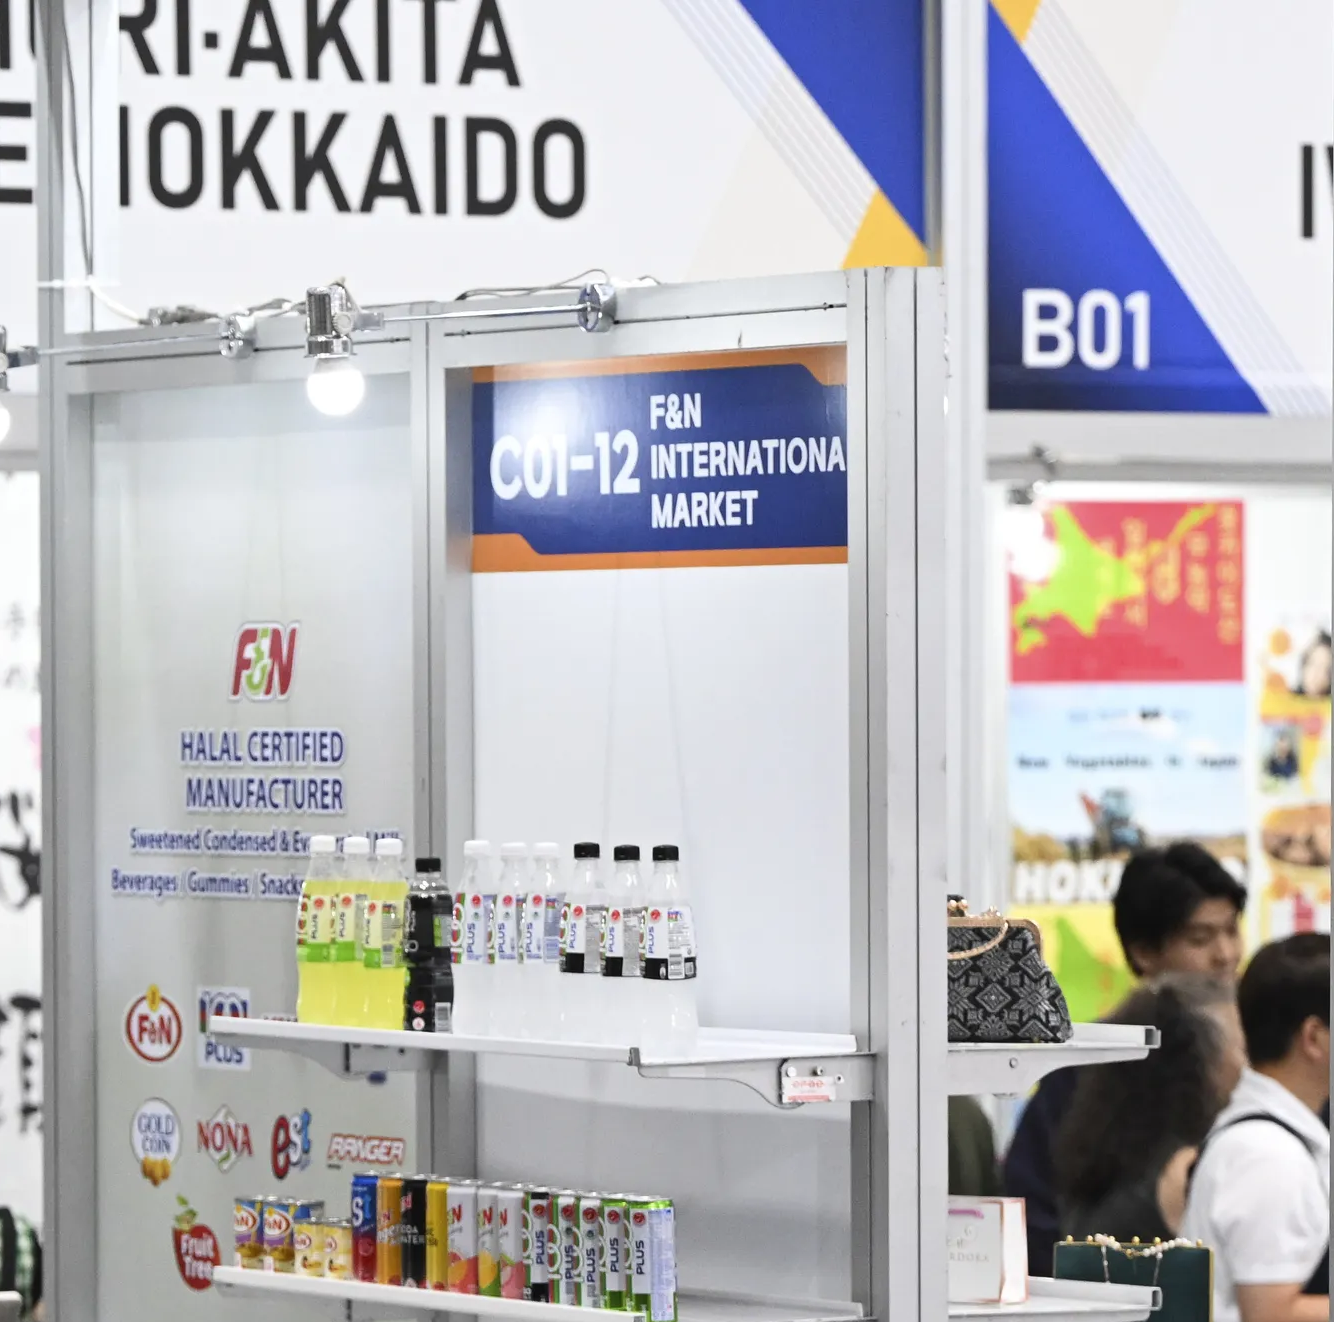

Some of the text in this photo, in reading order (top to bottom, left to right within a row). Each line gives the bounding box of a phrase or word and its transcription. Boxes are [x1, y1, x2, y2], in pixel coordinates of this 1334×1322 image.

[1021, 289, 1151, 371] B01
[650, 393, 702, 430] F&N
[490, 429, 846, 501] C01-12 INTERNATIONA
[651, 490, 758, 529] MARKET
[231, 626, 297, 696] F&N
[180, 731, 344, 762] HALAL CERTIFIED
[186, 777, 343, 809] MANUFACTURER
[130, 827, 200, 851] Sweetened
[204, 828, 276, 851] Condensed
[112, 868, 177, 897] Beverages
[188, 870, 249, 895] Gummies
[466, 923, 476, 953] PLUS
[497, 923, 506, 953] PLUS
[525, 923, 534, 953] PLUS
[138, 1013, 172, 1046] F&N
[204, 1040, 244, 1064] PLUS
[137, 1112, 175, 1135] GOLD
[197, 1120, 252, 1157] NONA
[141, 1136, 171, 1153] COIN
[327, 1133, 406, 1166] RANGER
[535, 1230, 545, 1265] PLUS
[565, 1244, 574, 1280] PLUS
[610, 1237, 619, 1273] PLUS
[636, 1240, 645, 1275] PLUS
[586, 1247, 596, 1283] PLUS
